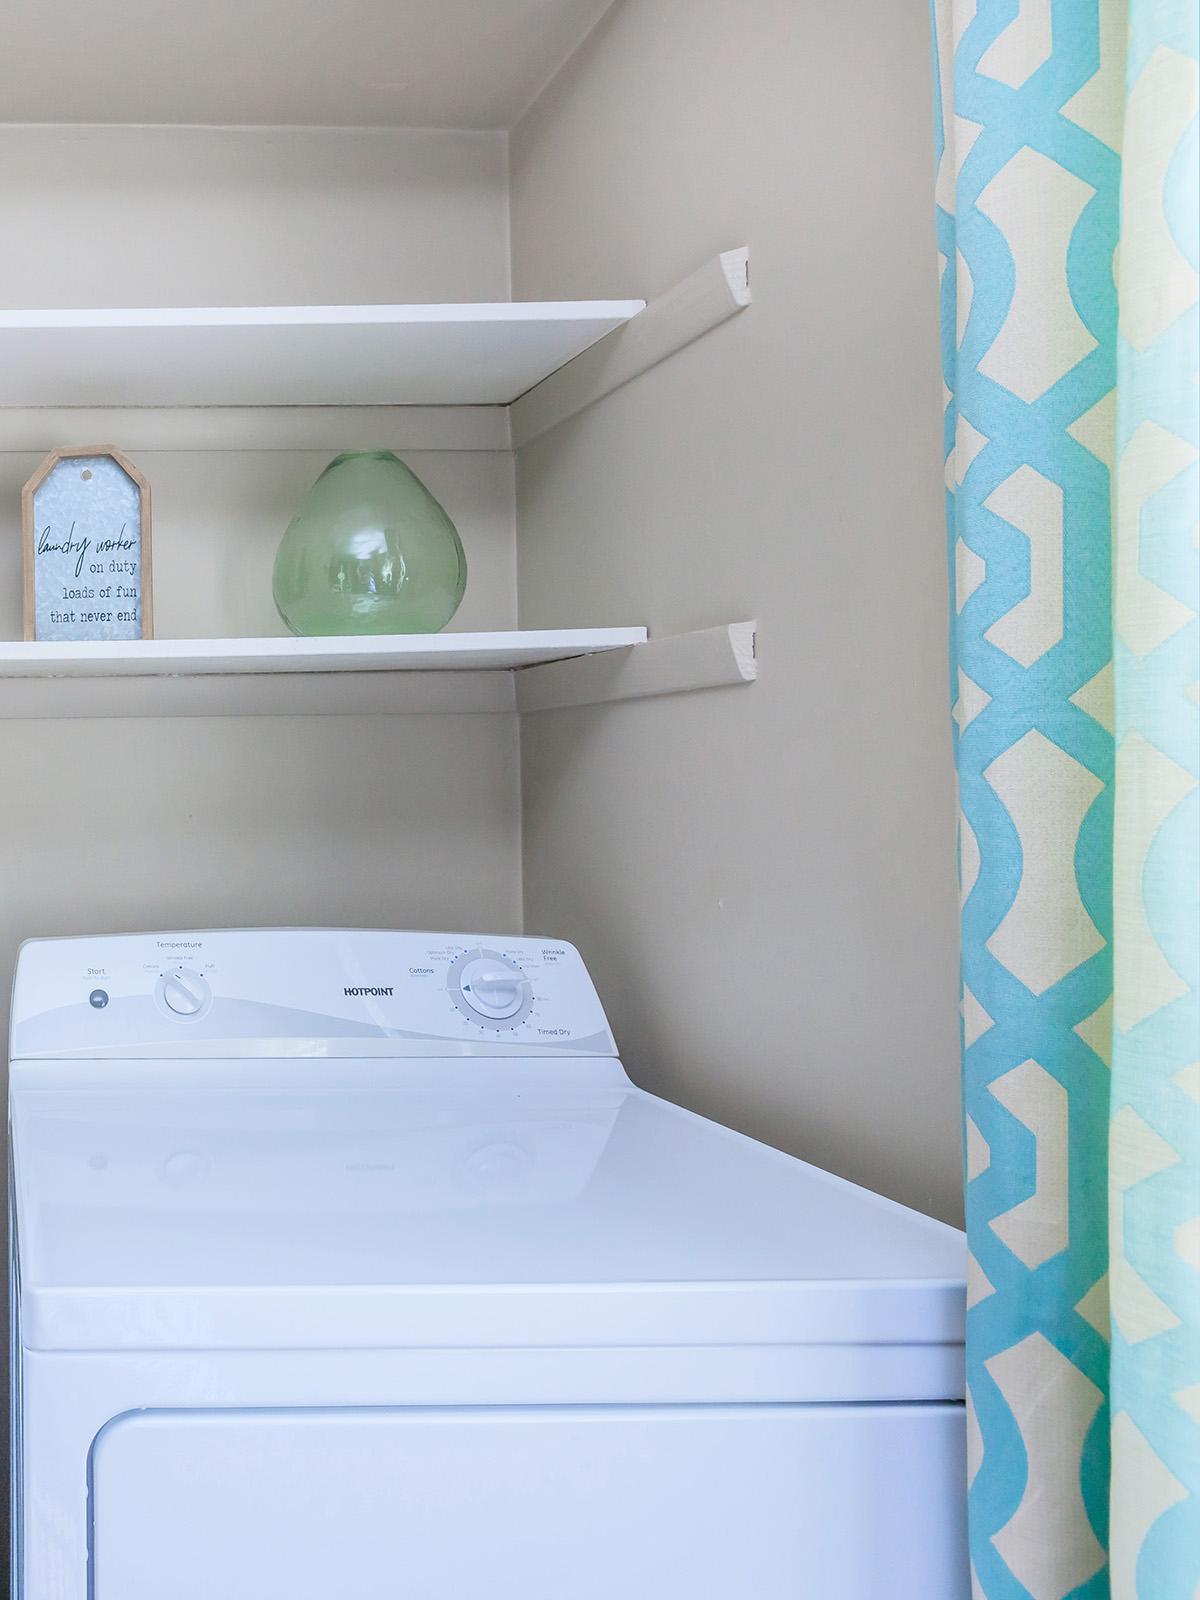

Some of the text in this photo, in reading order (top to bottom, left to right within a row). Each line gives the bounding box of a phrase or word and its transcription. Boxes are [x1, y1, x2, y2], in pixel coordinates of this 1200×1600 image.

[38, 521, 137, 578] laundry worker
[89, 560, 137, 575] on duty
[62, 585, 137, 599] loads of fun
[50, 608, 137, 623] that never end
[156, 941, 202, 949] Temperature
[344, 987, 394, 996] HOTPOINT
